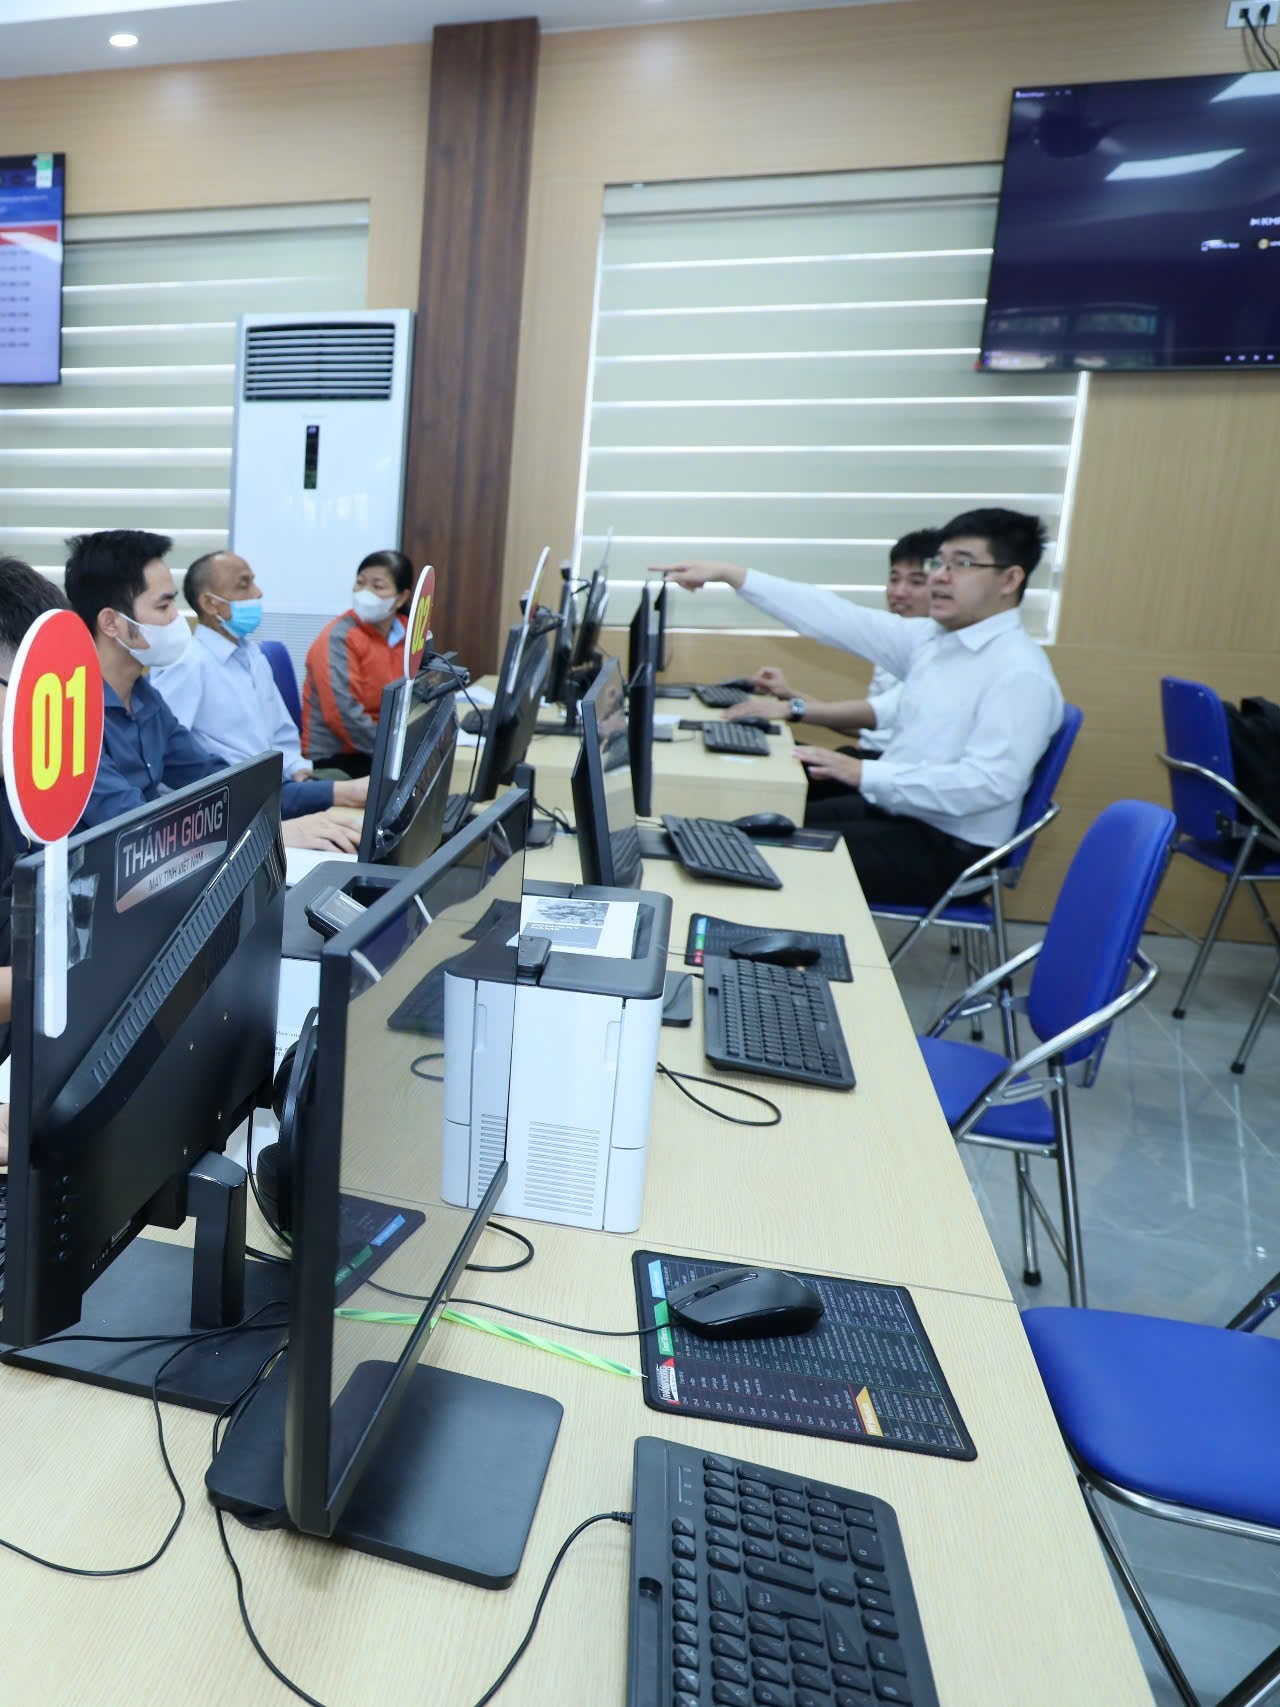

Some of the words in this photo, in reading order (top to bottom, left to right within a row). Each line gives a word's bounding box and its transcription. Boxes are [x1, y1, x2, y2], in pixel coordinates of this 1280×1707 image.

[411, 594, 431, 655] 02
[31, 666, 86, 791] 01
[123, 823, 177, 878] THÁNH
[181, 800, 224, 847] GIÓNG
